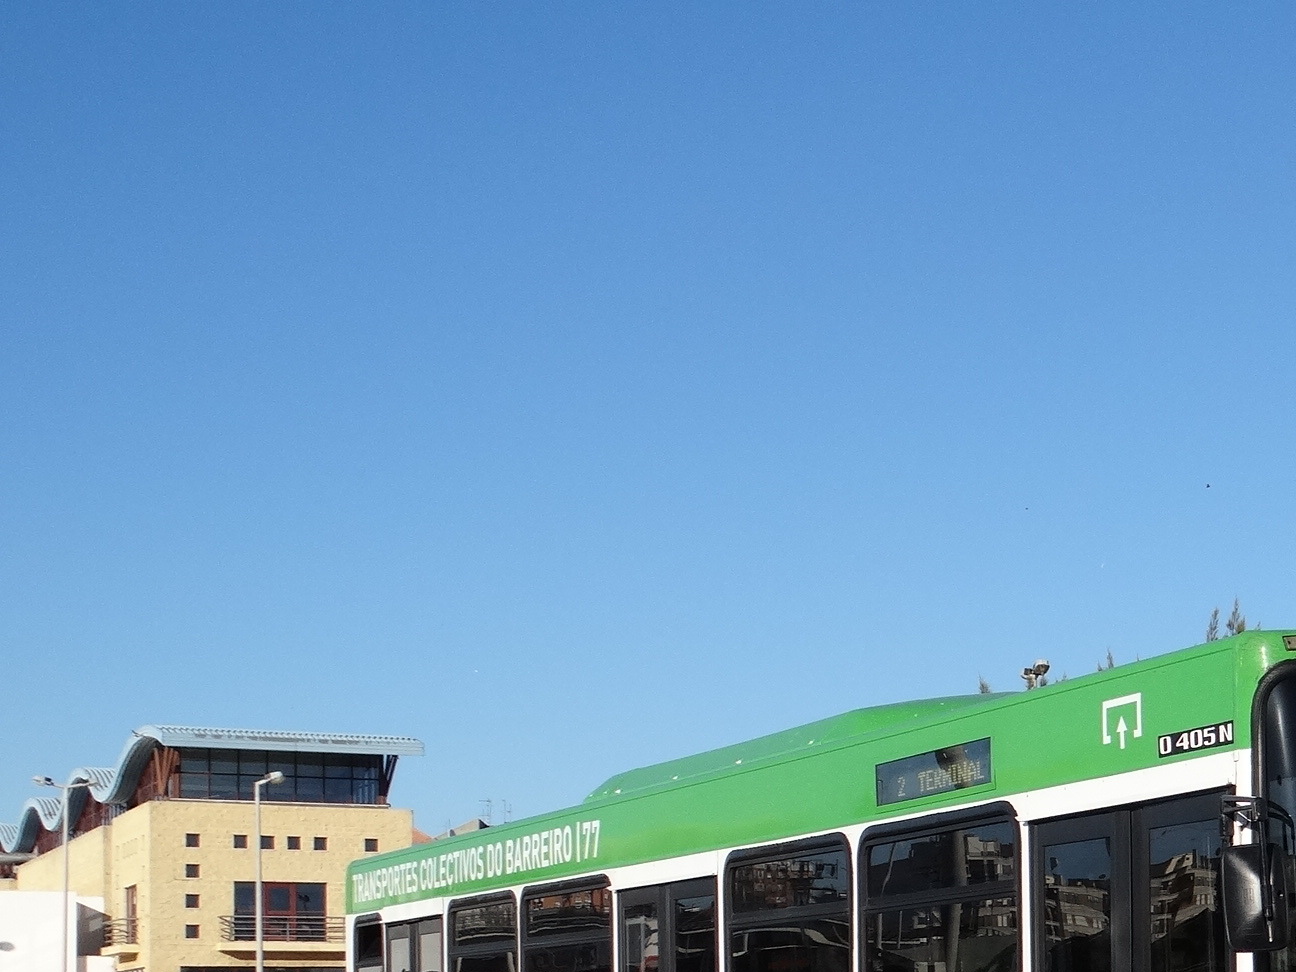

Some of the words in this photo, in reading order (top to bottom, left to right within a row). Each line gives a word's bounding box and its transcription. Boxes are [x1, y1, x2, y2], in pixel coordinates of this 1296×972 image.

[1175, 726, 1216, 750] 405
[1218, 722, 1233, 743] N
[918, 760, 985, 793] TERMINAL
[352, 861, 418, 903] TRANSPORTES
[420, 846, 484, 890] COLECTIVOS
[486, 840, 504, 878] DO
[506, 825, 572, 875] BARREIRO
